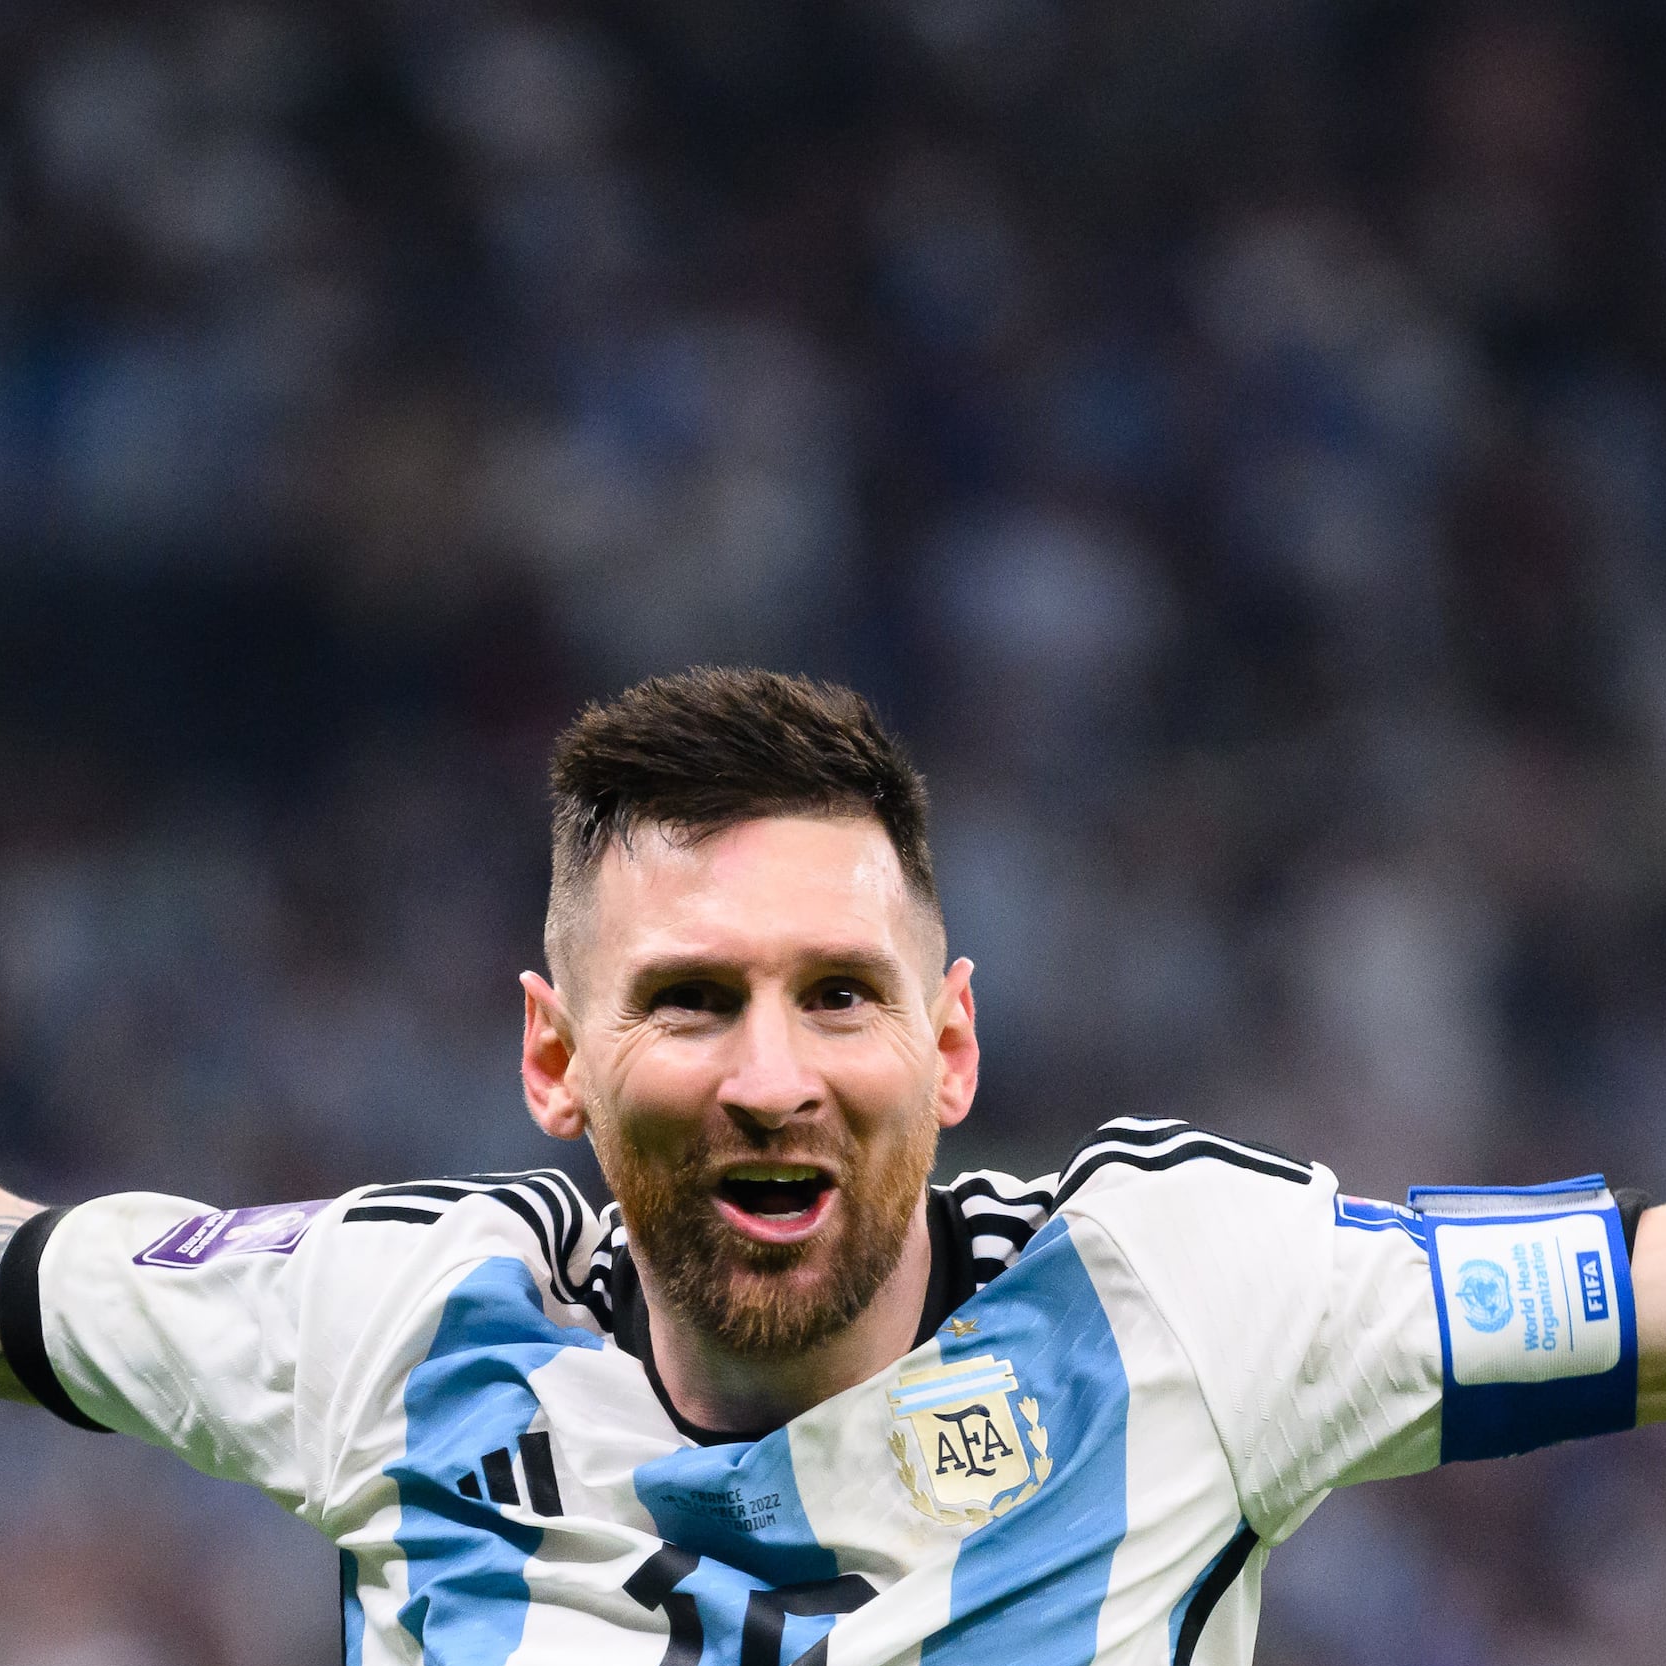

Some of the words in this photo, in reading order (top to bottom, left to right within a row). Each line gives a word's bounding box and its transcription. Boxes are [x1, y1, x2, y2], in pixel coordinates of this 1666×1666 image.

[1511, 1243, 1531, 1291] Health
[1582, 1259, 1603, 1313] FIFA
[1532, 1241, 1559, 1351] Organization
[1520, 1298, 1539, 1351] World
[933, 1403, 1014, 1477] AFA
[689, 1488, 743, 1505] FRANCE
[749, 1492, 782, 1514] 2022
